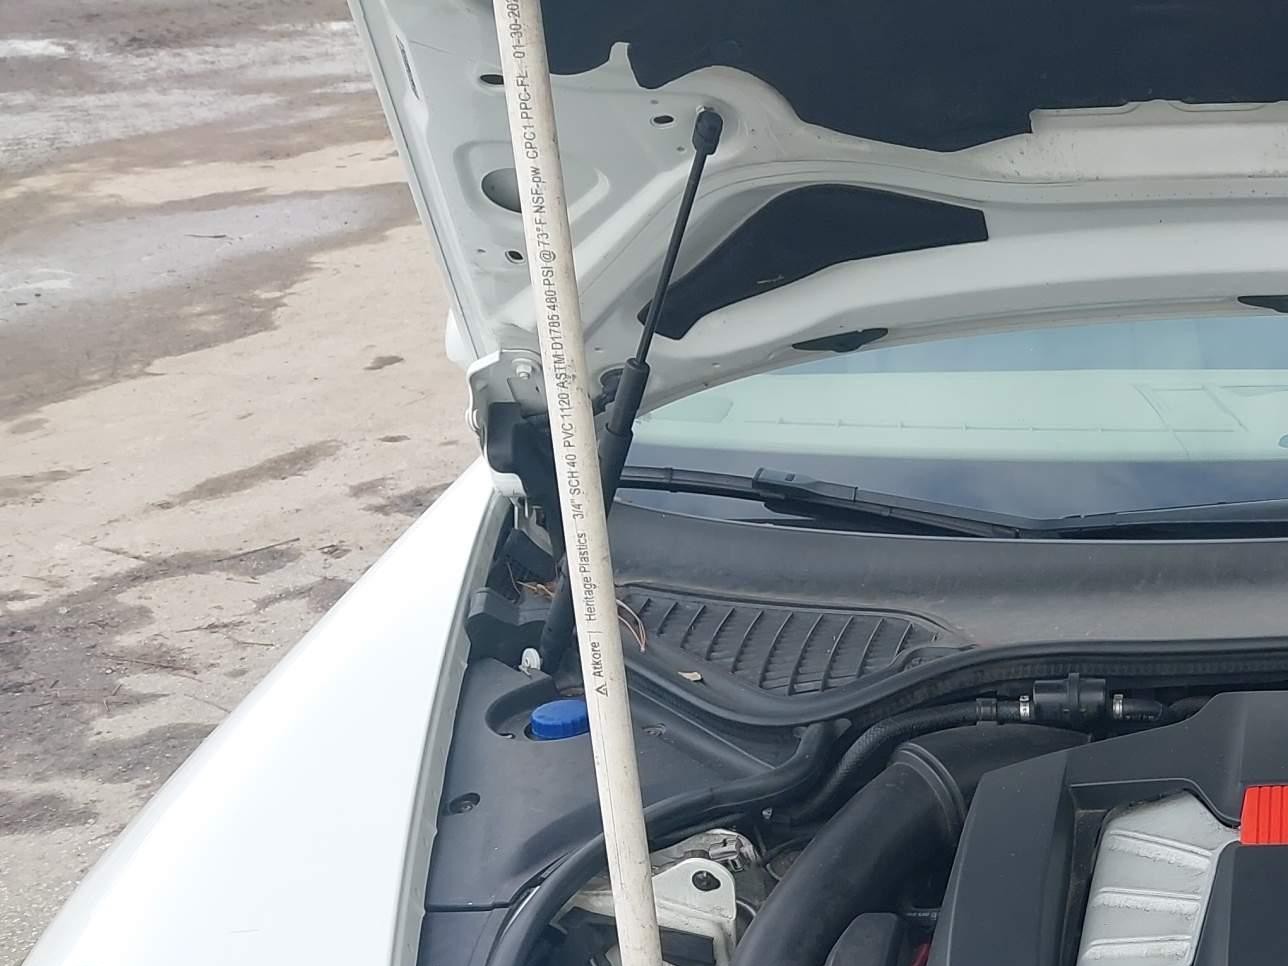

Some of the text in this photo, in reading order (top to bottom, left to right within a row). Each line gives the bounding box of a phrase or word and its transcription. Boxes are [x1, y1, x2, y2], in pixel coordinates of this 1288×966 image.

[522, 123, 539, 159] CPC1
[530, 166, 546, 214] NSF-pw
[539, 249, 556, 263] @
[541, 265, 555, 286] PSI
[544, 289, 557, 311] 480
[547, 312, 563, 351] D1785
[552, 353, 569, 391] ASTM
[557, 392, 572, 418] 1120
[561, 422, 575, 448] PVC
[565, 453, 577, 468] 40
[567, 470, 581, 495] SCH
[570, 498, 584, 520] 3/4"
[576, 532, 591, 573] Plastics
[583, 576, 597, 622] Heritage
[590, 641, 604, 678] Atkore
